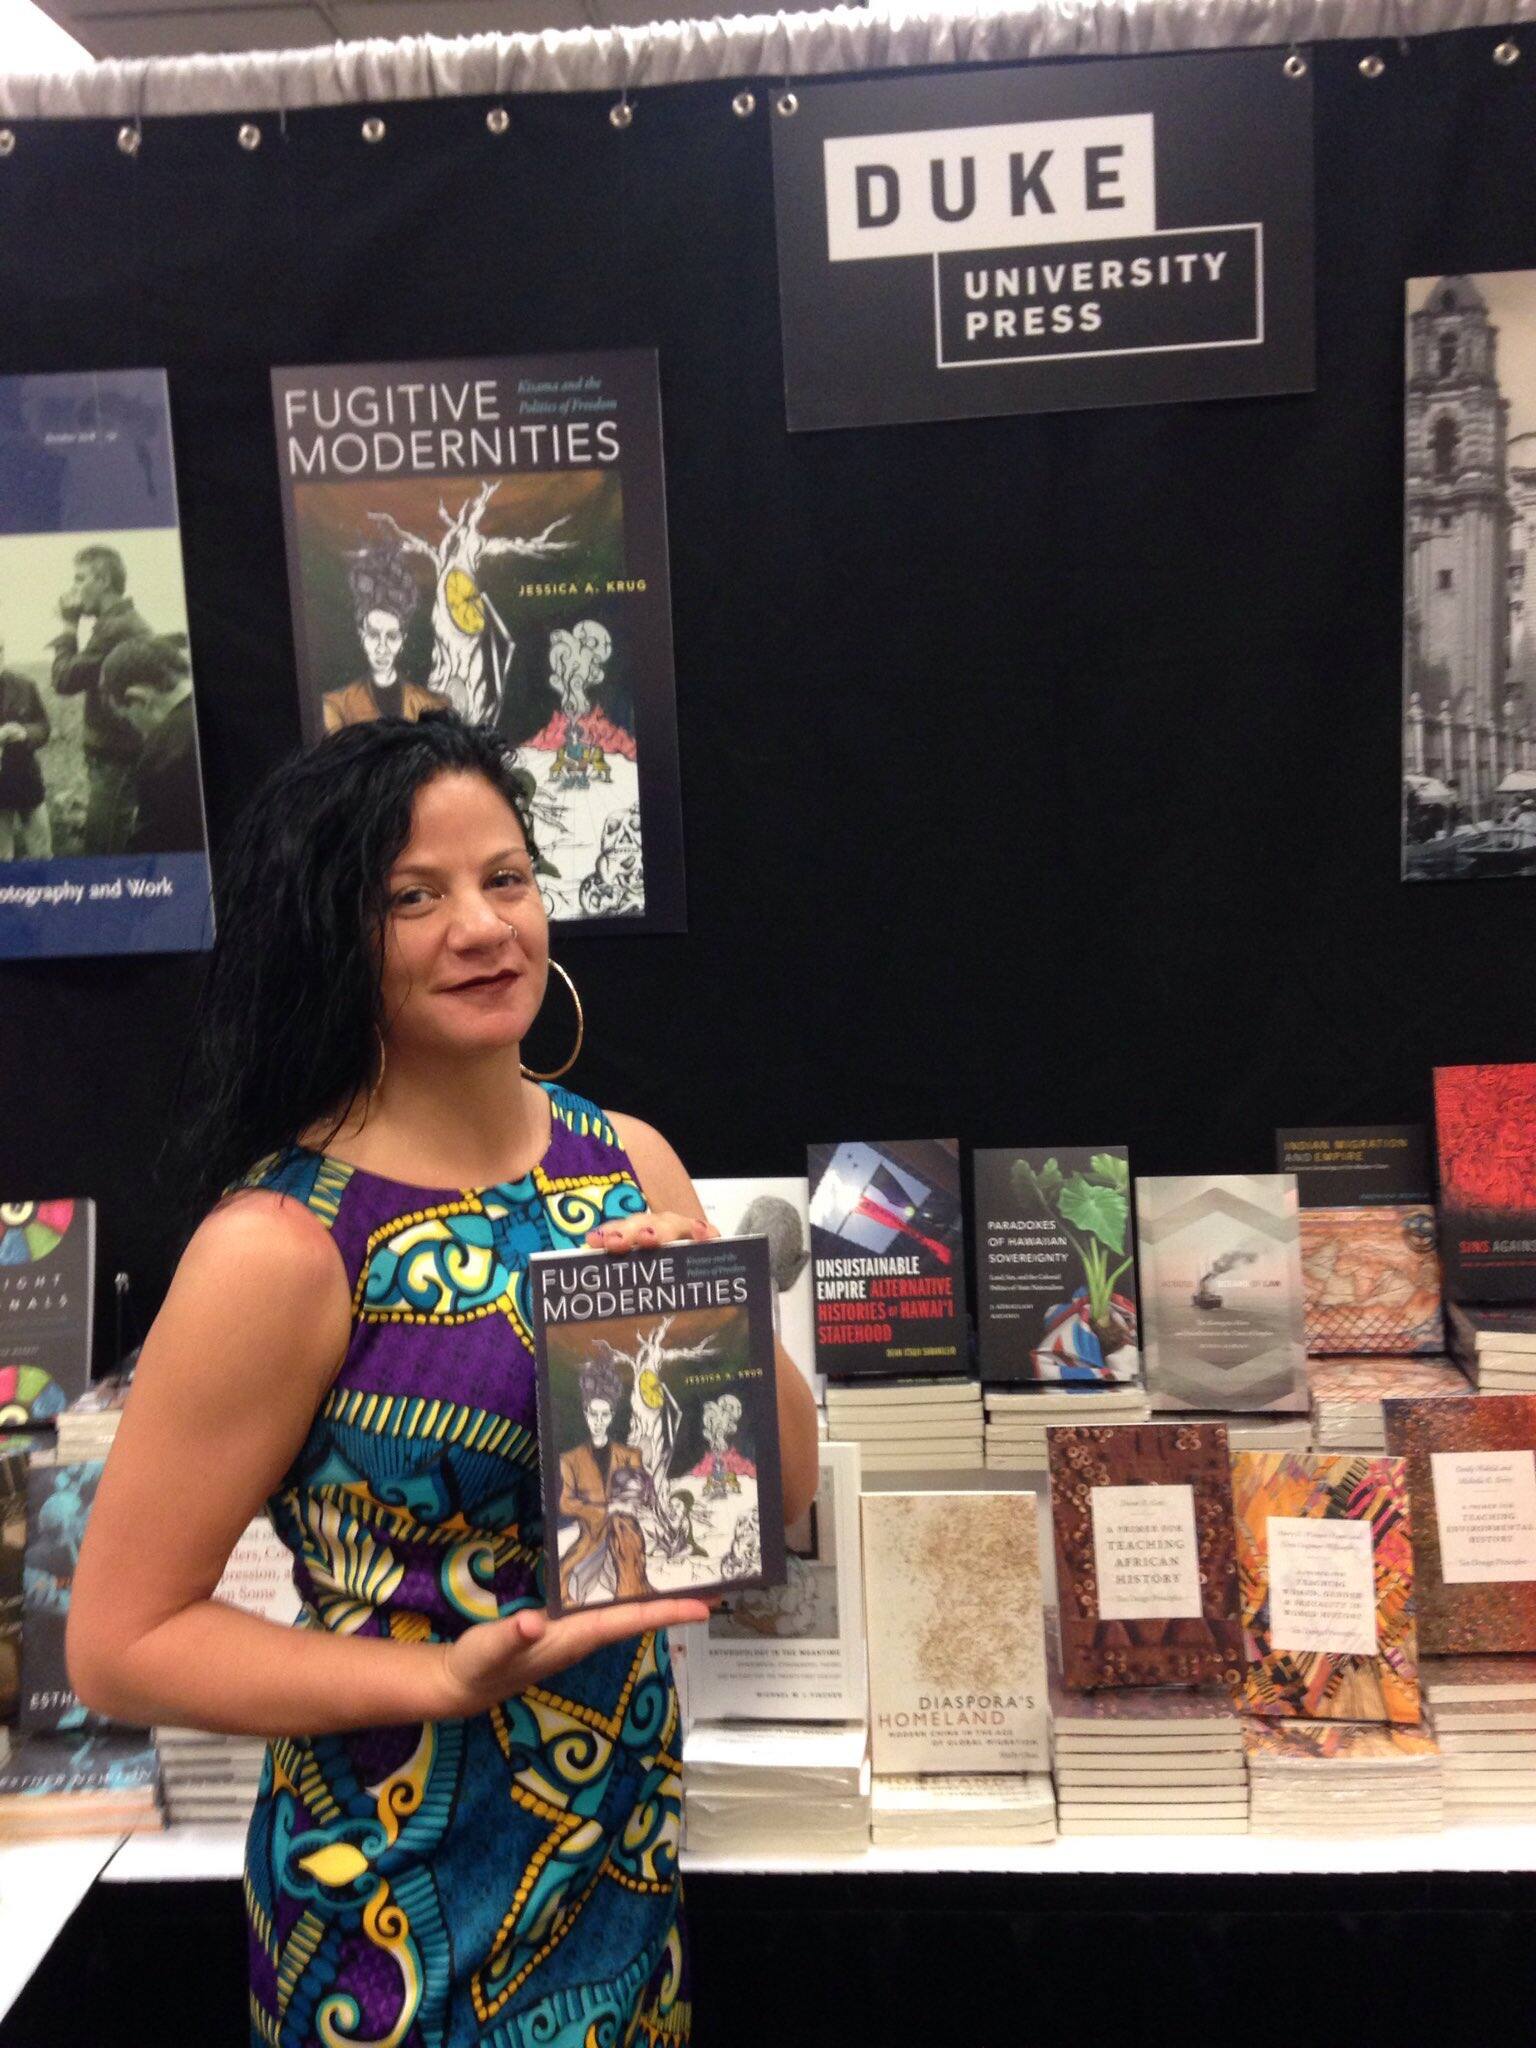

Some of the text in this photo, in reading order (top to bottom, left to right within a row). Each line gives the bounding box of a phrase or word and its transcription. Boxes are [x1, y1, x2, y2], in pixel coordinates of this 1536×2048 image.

[854, 144, 1126, 230] DUKE
[964, 251, 1229, 300] UNIVERSITY
[966, 302, 1102, 341] PRESS
[284, 379, 501, 431] FUGITIVE
[571, 396, 618, 412] Freedom
[288, 420, 621, 476] MODERNITIES
[519, 579, 647, 597] JESSICA A. KRUG
[89, 878, 122, 900] and
[126, 876, 174, 898] Work
[1284, 1151, 1366, 1162] AND EMPIRE
[987, 1220, 1057, 1231] PARADOXES
[987, 1236, 1068, 1247] OF HAWAIIAN
[815, 1256, 921, 1278] UNSUSTAINABLE
[988, 1253, 1069, 1264] SOVEREIGNTY
[541, 1257, 676, 1296] FUGITIVE
[816, 1276, 953, 1301] EMPIRE ALTERNATIVE
[543, 1277, 748, 1323] MODERNITIES
[817, 1301, 886, 1322] HISTORIES
[818, 1323, 893, 1345] STATEHOOD
[1463, 1513, 1515, 1522] TEACHING
[1106, 1539, 1185, 1551] TEACHING
[1468, 1535, 1513, 1544] HISTORY
[1114, 1556, 1180, 1568] AFRICAN
[1115, 1573, 1180, 1585] HISTORY
[918, 1695, 1035, 1711] DIASPORA'S
[878, 1710, 1006, 1729] HOMELAND
[888, 1730, 927, 1738] MODERN
[930, 1730, 958, 1738] CHINA
